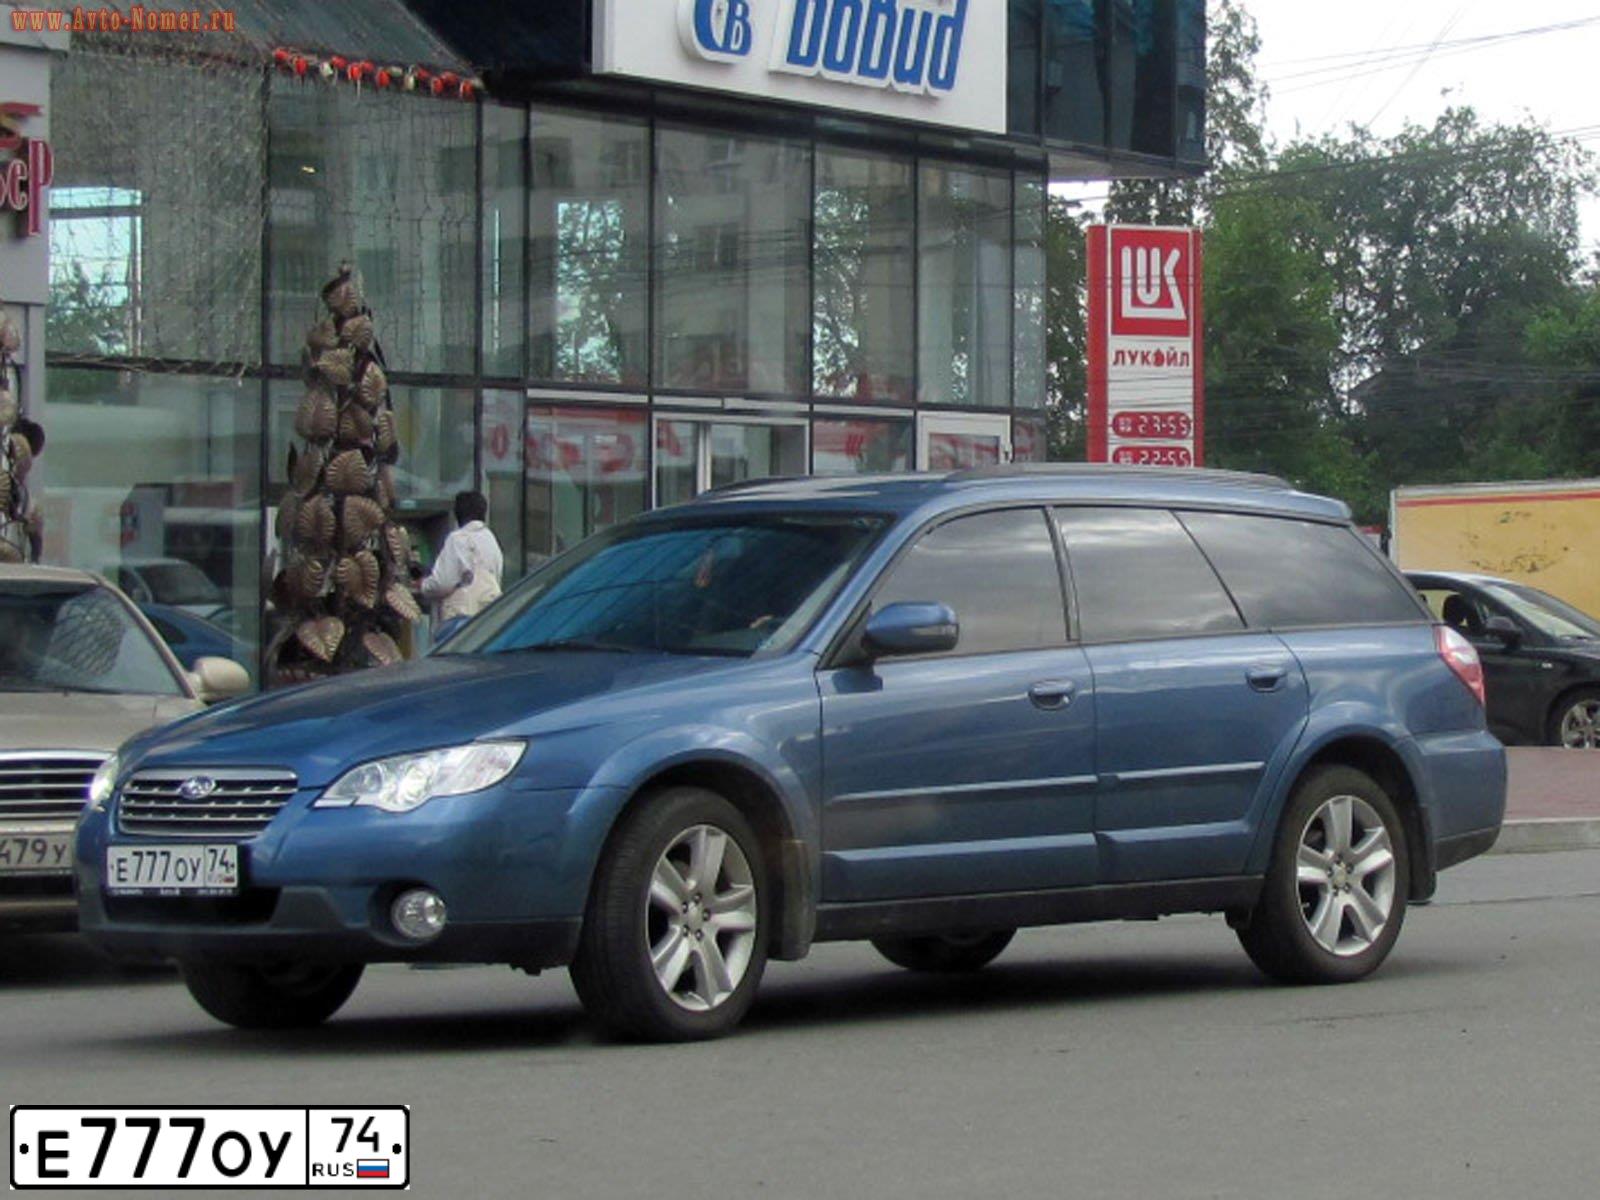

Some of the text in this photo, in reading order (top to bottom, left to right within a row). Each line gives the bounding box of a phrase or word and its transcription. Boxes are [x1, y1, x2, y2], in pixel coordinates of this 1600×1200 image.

[0, 138, 54, 236] ер
[1112, 347, 1190, 367] ЛУКОЙЛ
[117, 848, 231, 882] Е777ОУ 74
